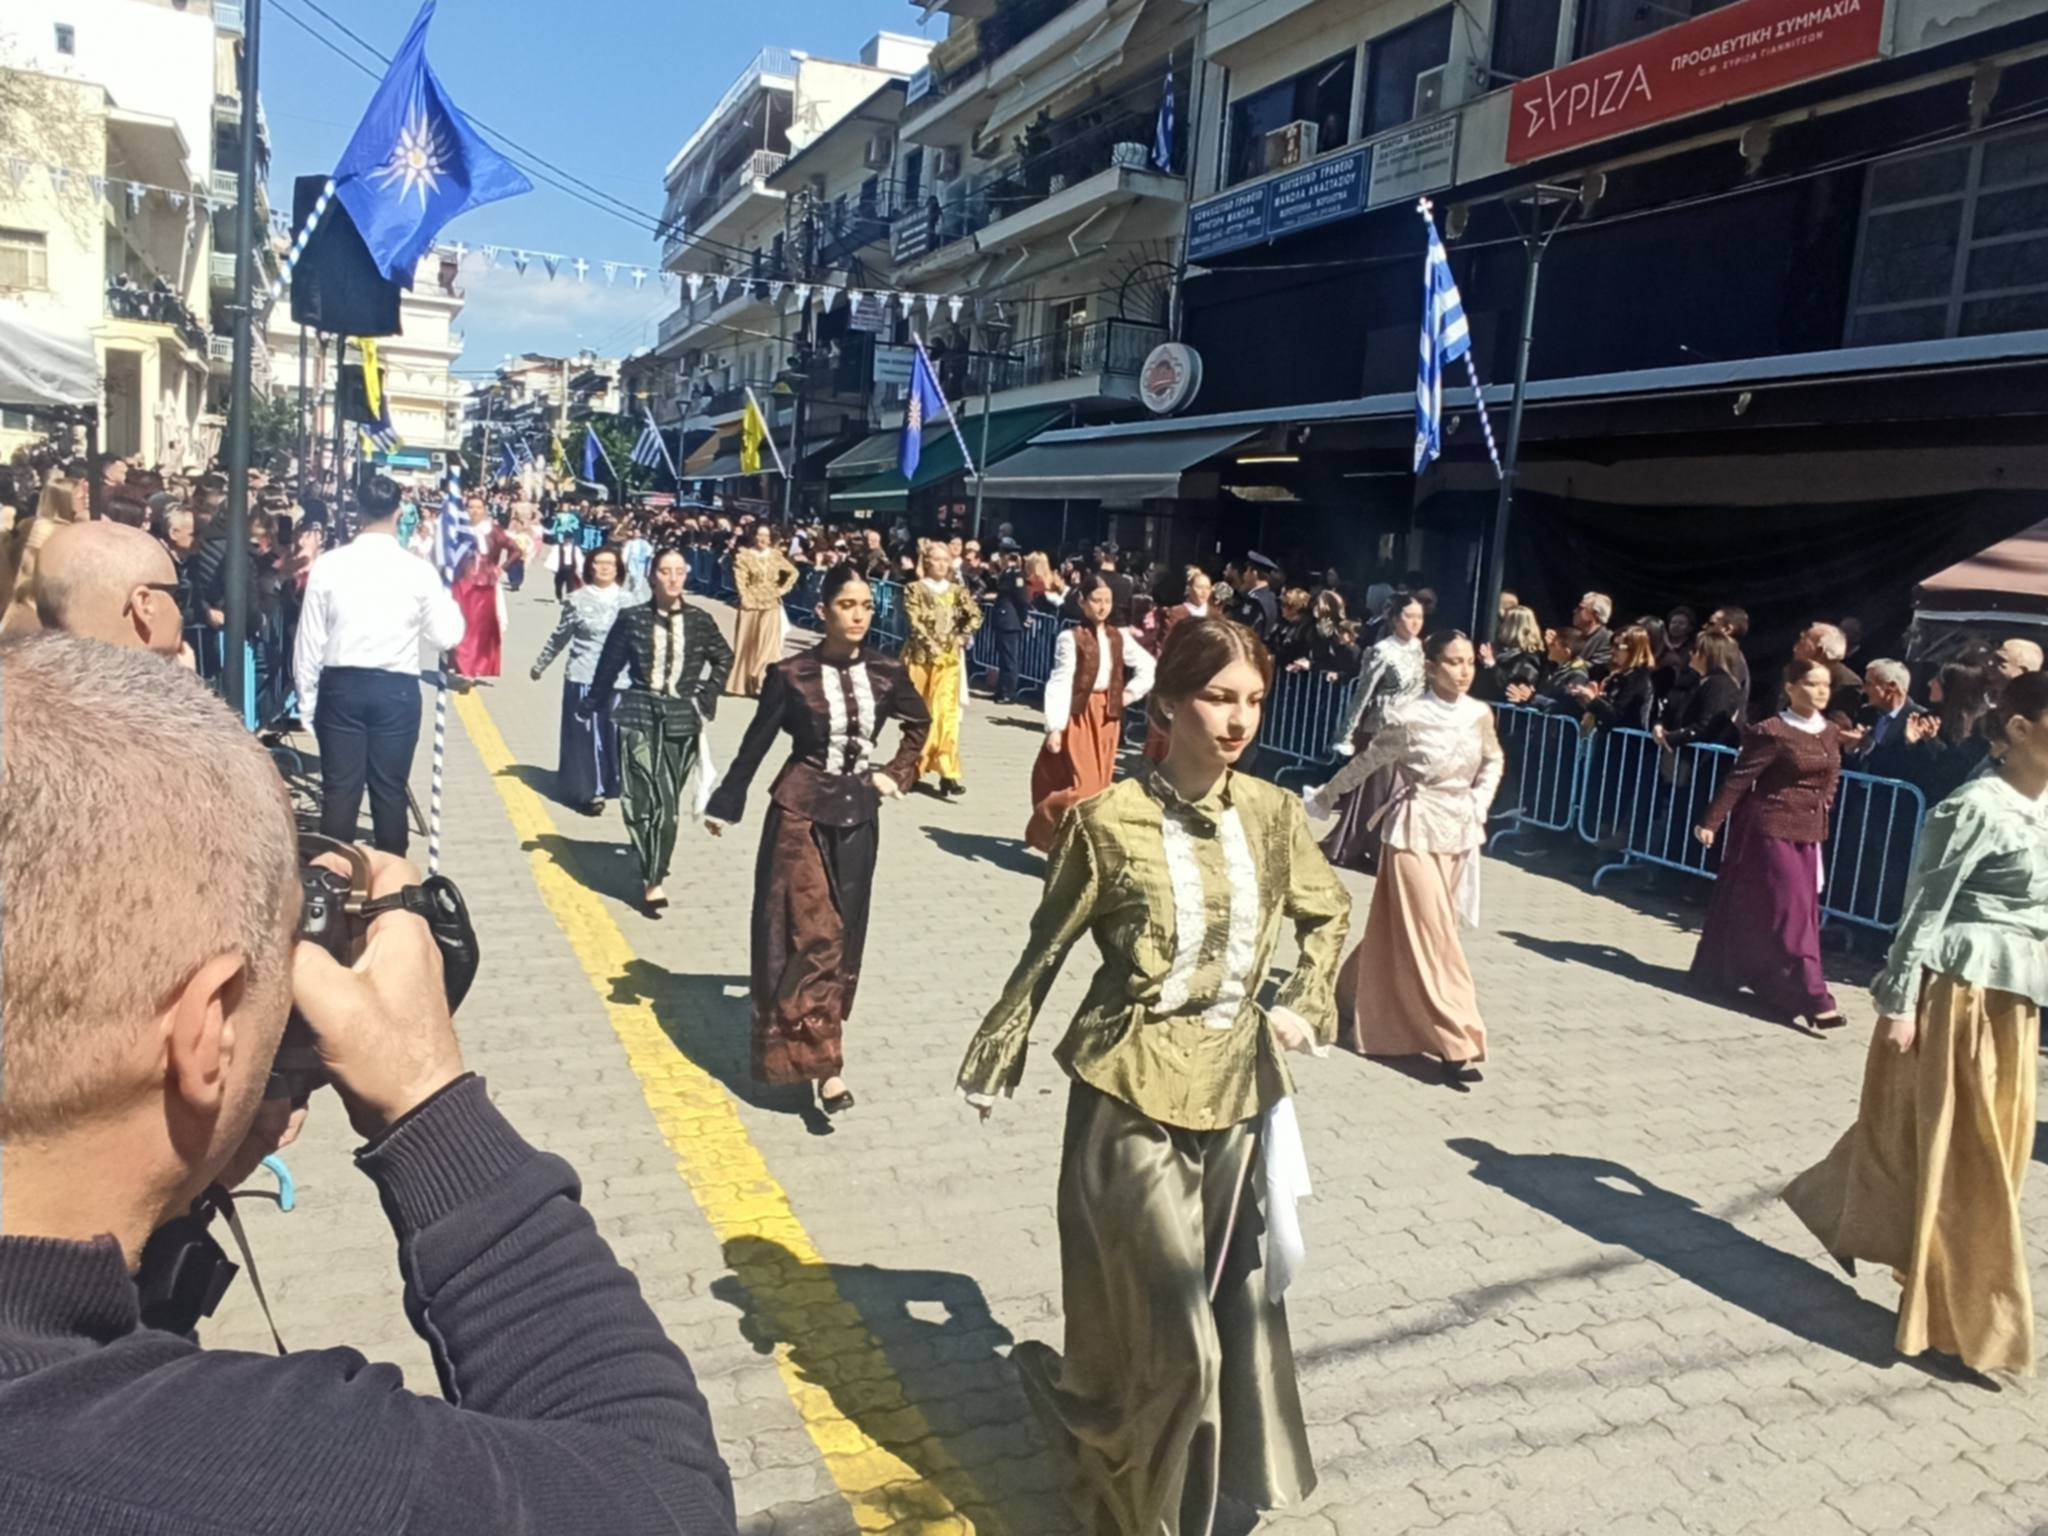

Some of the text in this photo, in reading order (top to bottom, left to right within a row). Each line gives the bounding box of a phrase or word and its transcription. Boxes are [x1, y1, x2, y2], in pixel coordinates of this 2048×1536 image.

[1671, 0, 1862, 73] ΠΡΟΟΔΕΥΤΙΚΗ ΣΥΜΜΑΧΙΑ
[1523, 63, 1652, 138] ΣΥΡΙΖΑ
[1308, 173, 1357, 197] ΑΝΑΣΤΑΣΙΟΥ
[1319, 159, 1354, 180] ΓΡΑΦΕΙΟ
